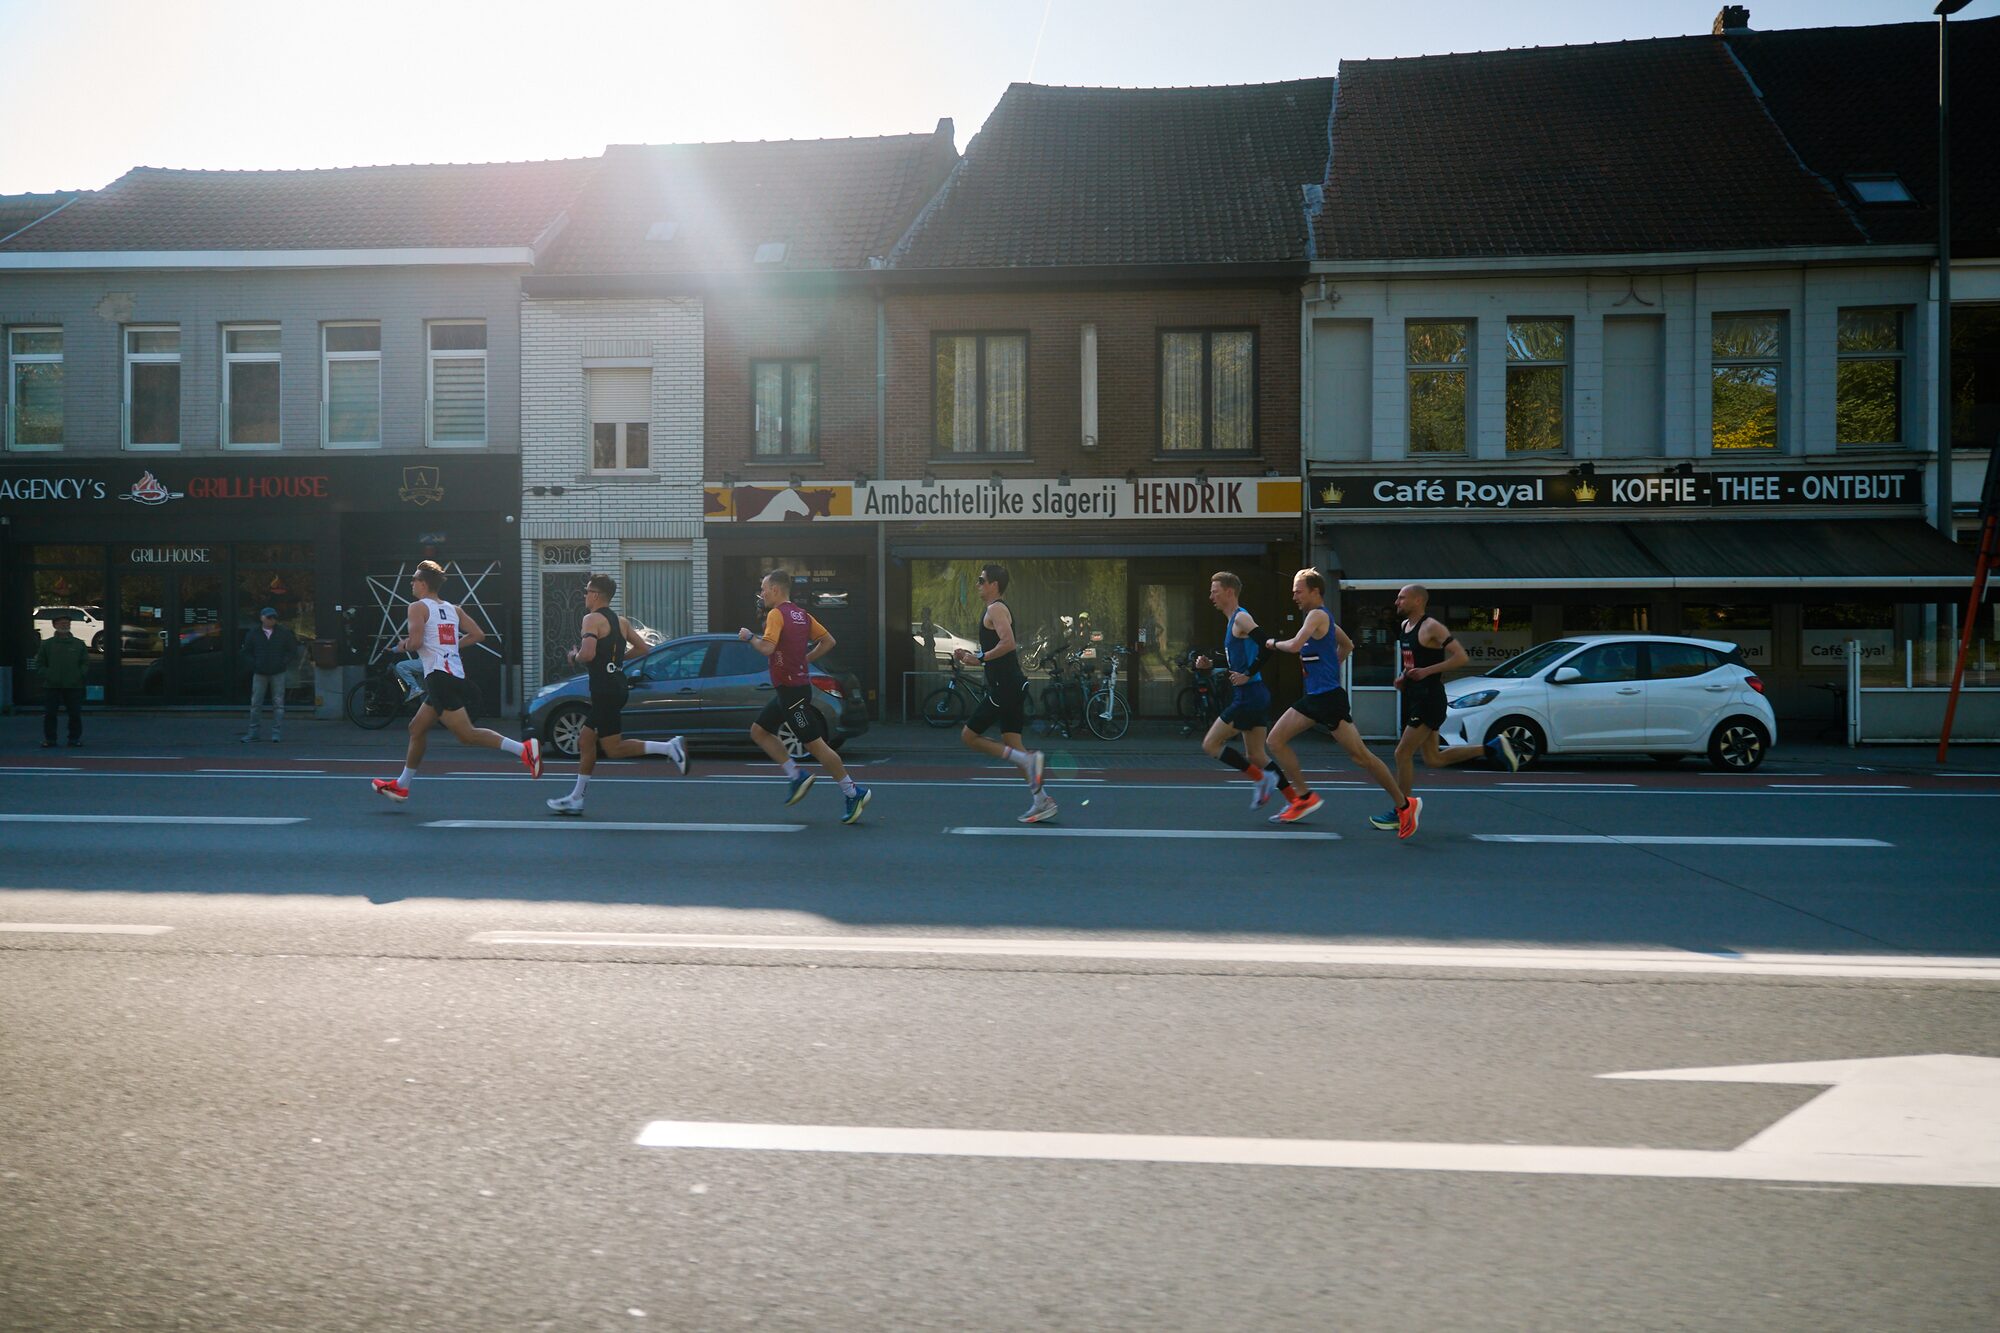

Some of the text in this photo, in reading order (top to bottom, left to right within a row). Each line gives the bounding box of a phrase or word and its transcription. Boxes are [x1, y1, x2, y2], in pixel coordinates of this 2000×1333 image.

[188, 476, 328, 498] GRILLHOUSE
[1373, 479, 1543, 507] Café Royal
[1612, 478, 1696, 502] KOFFIE
[1717, 476, 1781, 500] THEE
[1802, 475, 1905, 499] ONTBIJT
[864, 482, 1243, 518] Ambachtelijke slagerij HENDRIK
[131, 548, 210, 563] GRILLHOUSE
[1464, 646, 1483, 657] afé
[1738, 645, 1764, 660] oyal
[1810, 645, 1844, 657] Café
